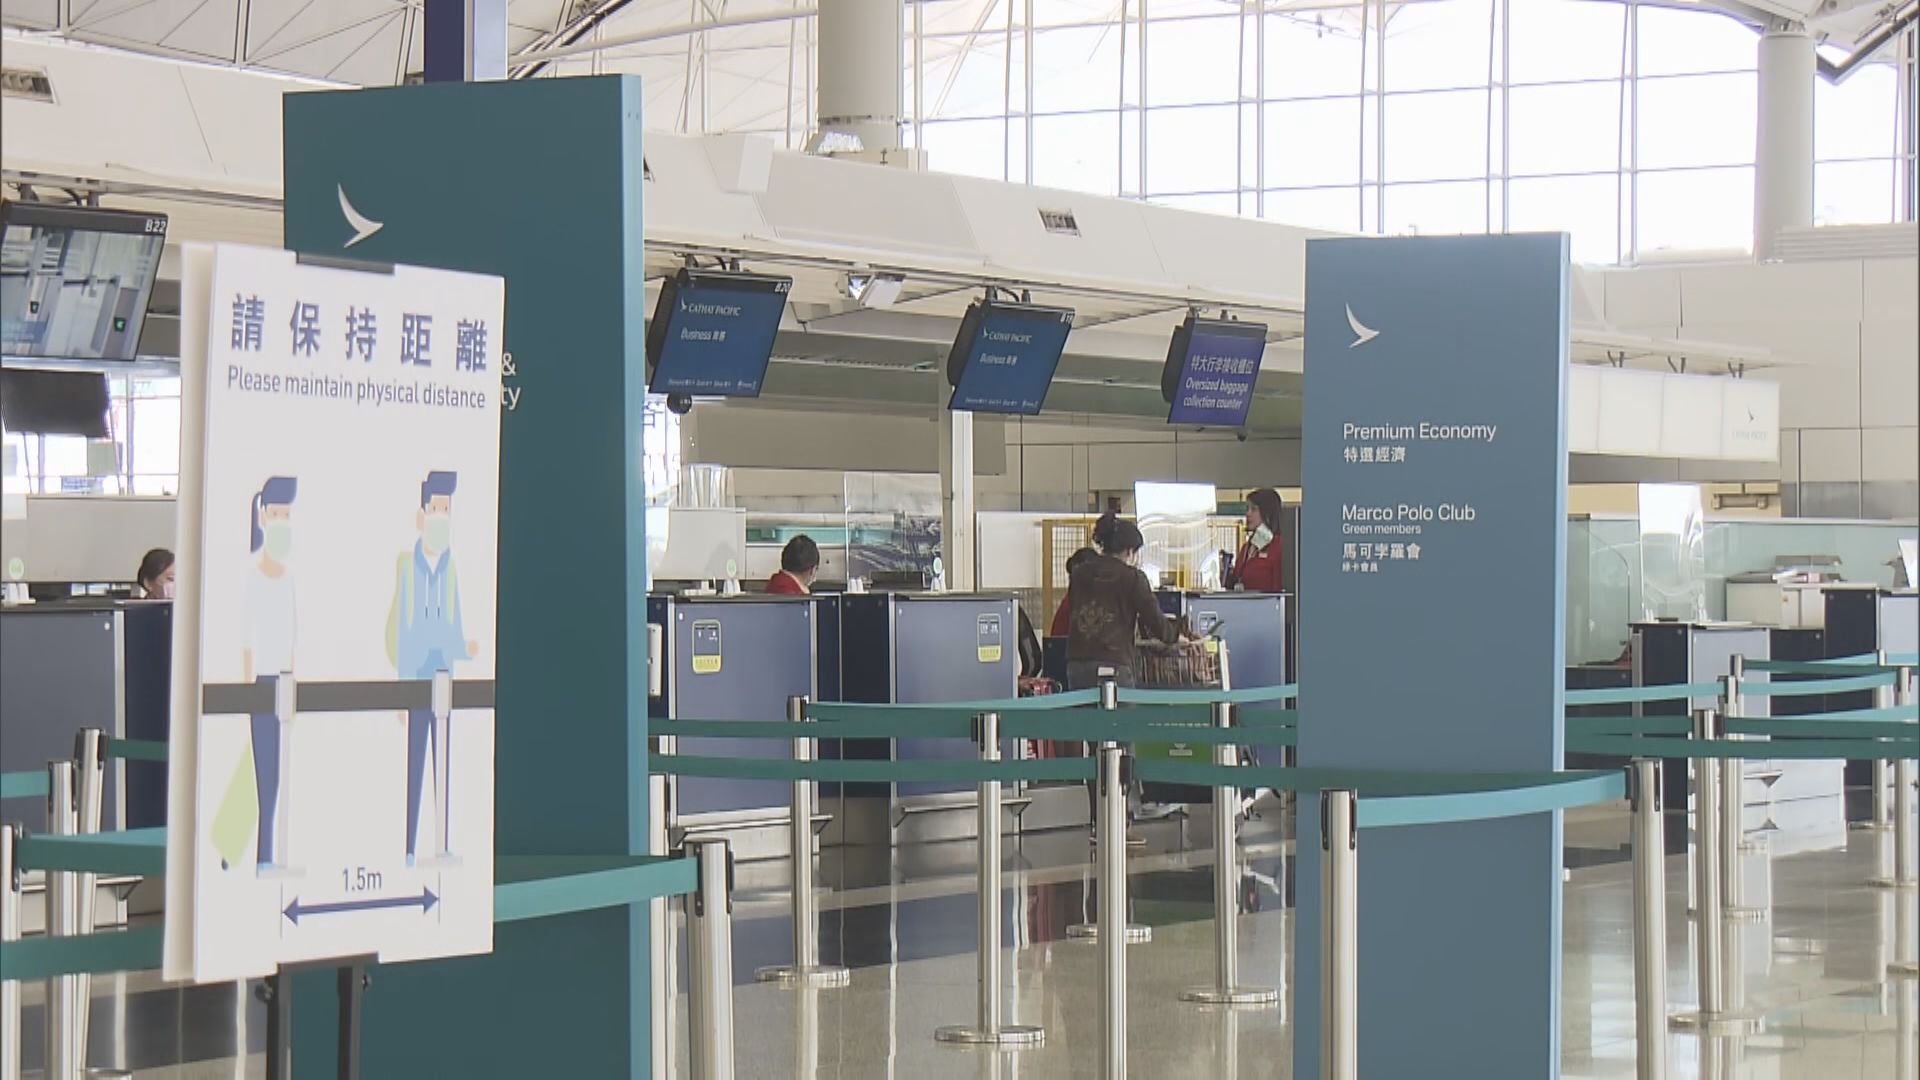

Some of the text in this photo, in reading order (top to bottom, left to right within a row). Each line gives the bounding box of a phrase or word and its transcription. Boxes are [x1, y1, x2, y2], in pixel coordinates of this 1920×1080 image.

[145, 219, 166, 232] B22
[688, 303, 741, 317] CATHAY PACIFIC
[231, 293, 487, 373] 請保持距離
[681, 327, 711, 341] Business
[501, 352, 516, 376] &
[228, 365, 486, 409] Please maintain physical distance
[1185, 376, 1249, 396] Oversized baggage
[1183, 394, 1243, 410] collection counter
[1343, 422, 1497, 442] Premium Economy
[1343, 446, 1406, 463] 特選經濟
[1342, 503, 1476, 521] Marco Polo Club
[1342, 523, 1422, 535] Green members
[342, 866, 382, 893] 1.5m
